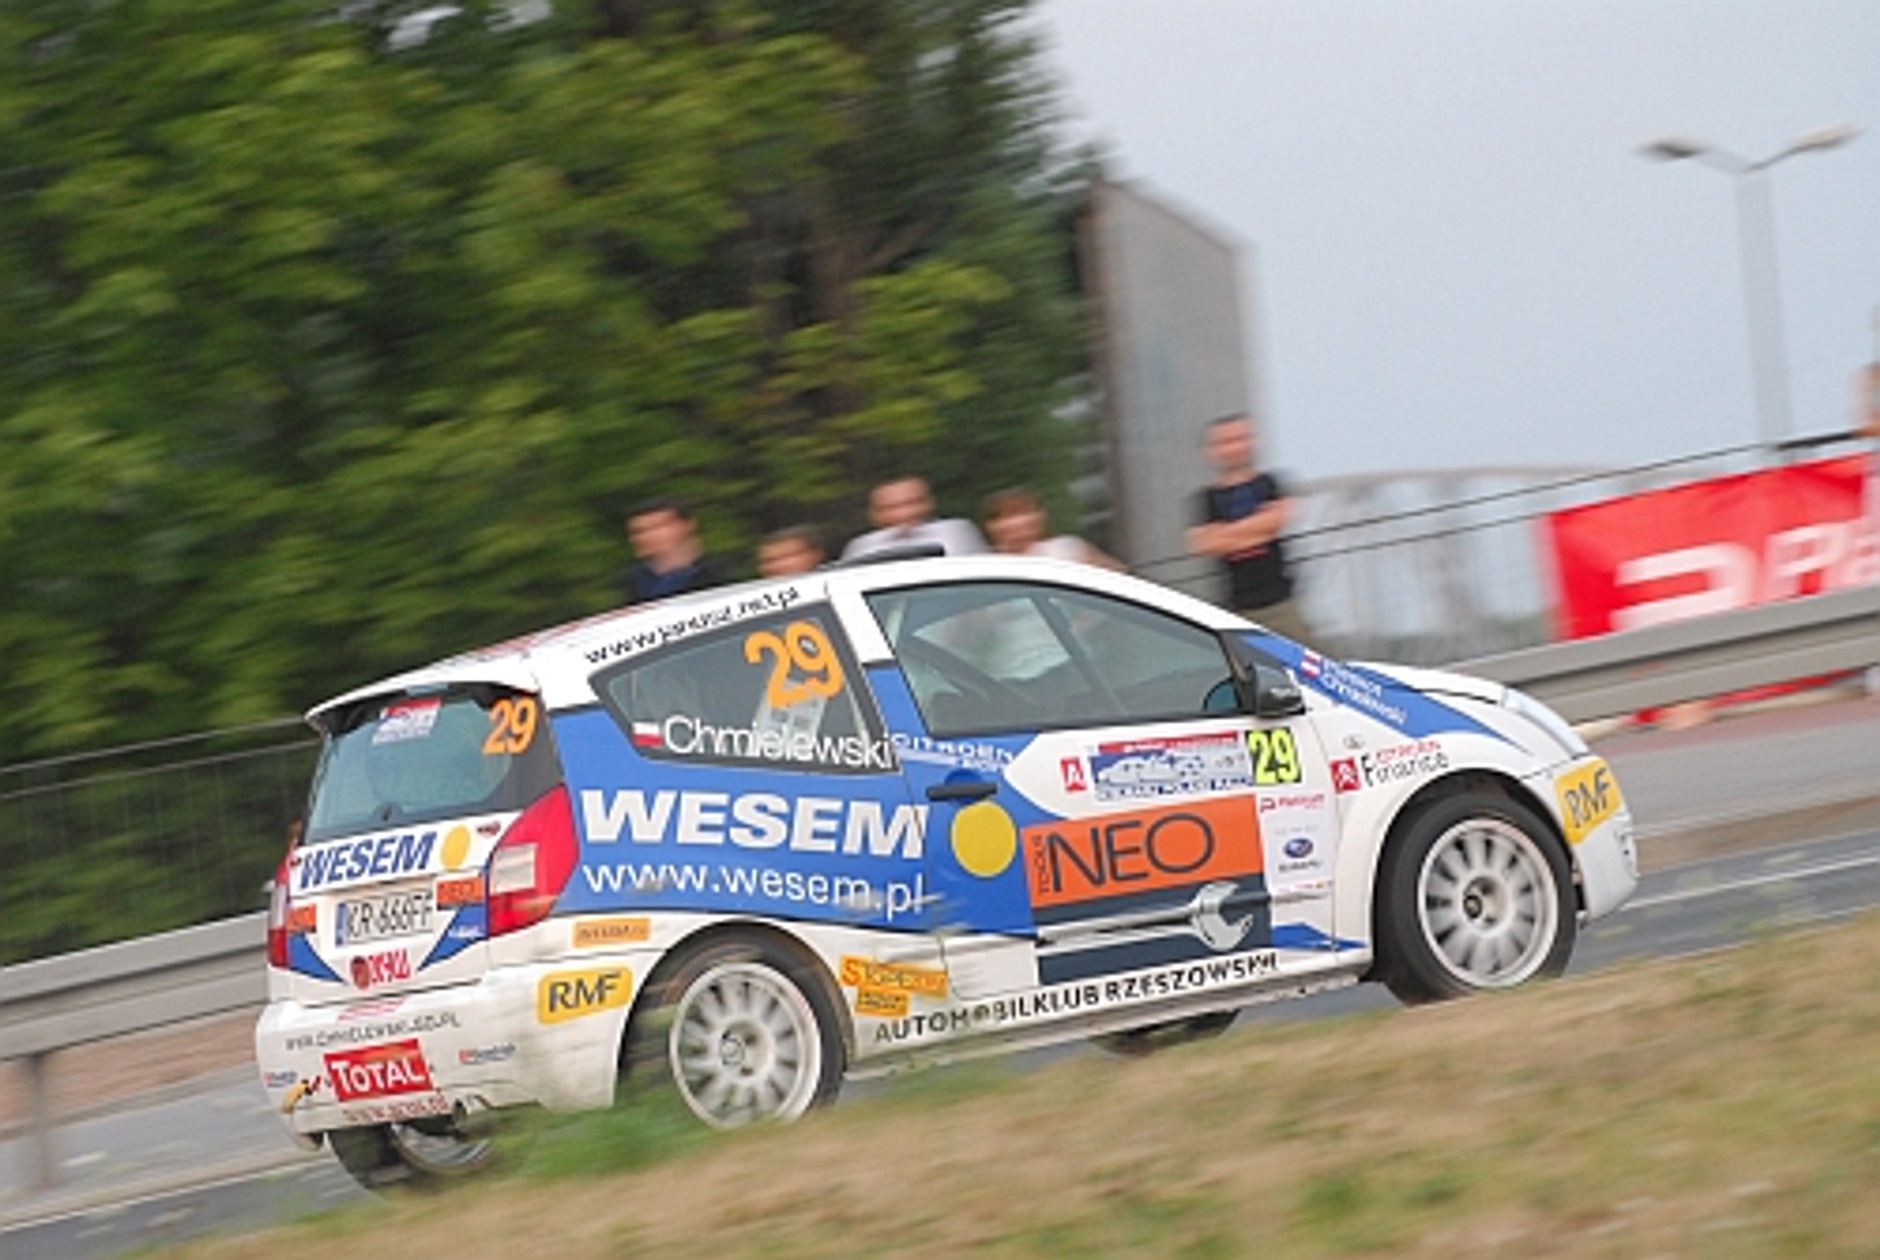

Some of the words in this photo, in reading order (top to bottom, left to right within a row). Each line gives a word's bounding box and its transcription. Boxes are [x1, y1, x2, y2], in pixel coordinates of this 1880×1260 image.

[743, 620, 844, 707] 29
[481, 697, 537, 755] 29
[663, 714, 893, 769] Chmielewski
[1247, 727, 1301, 785] 29
[579, 789, 930, 859] WESEM
[1564, 766, 1611, 829] RMF
[300, 832, 437, 889] WESEM
[1047, 812, 1215, 893] NEO
[582, 864, 924, 919] www.wesem.pl
[548, 969, 622, 1013] RMF
[874, 985, 1100, 1045] AUTOMOBILKLUB
[1104, 951, 1278, 1001] RZESZOWSKI
